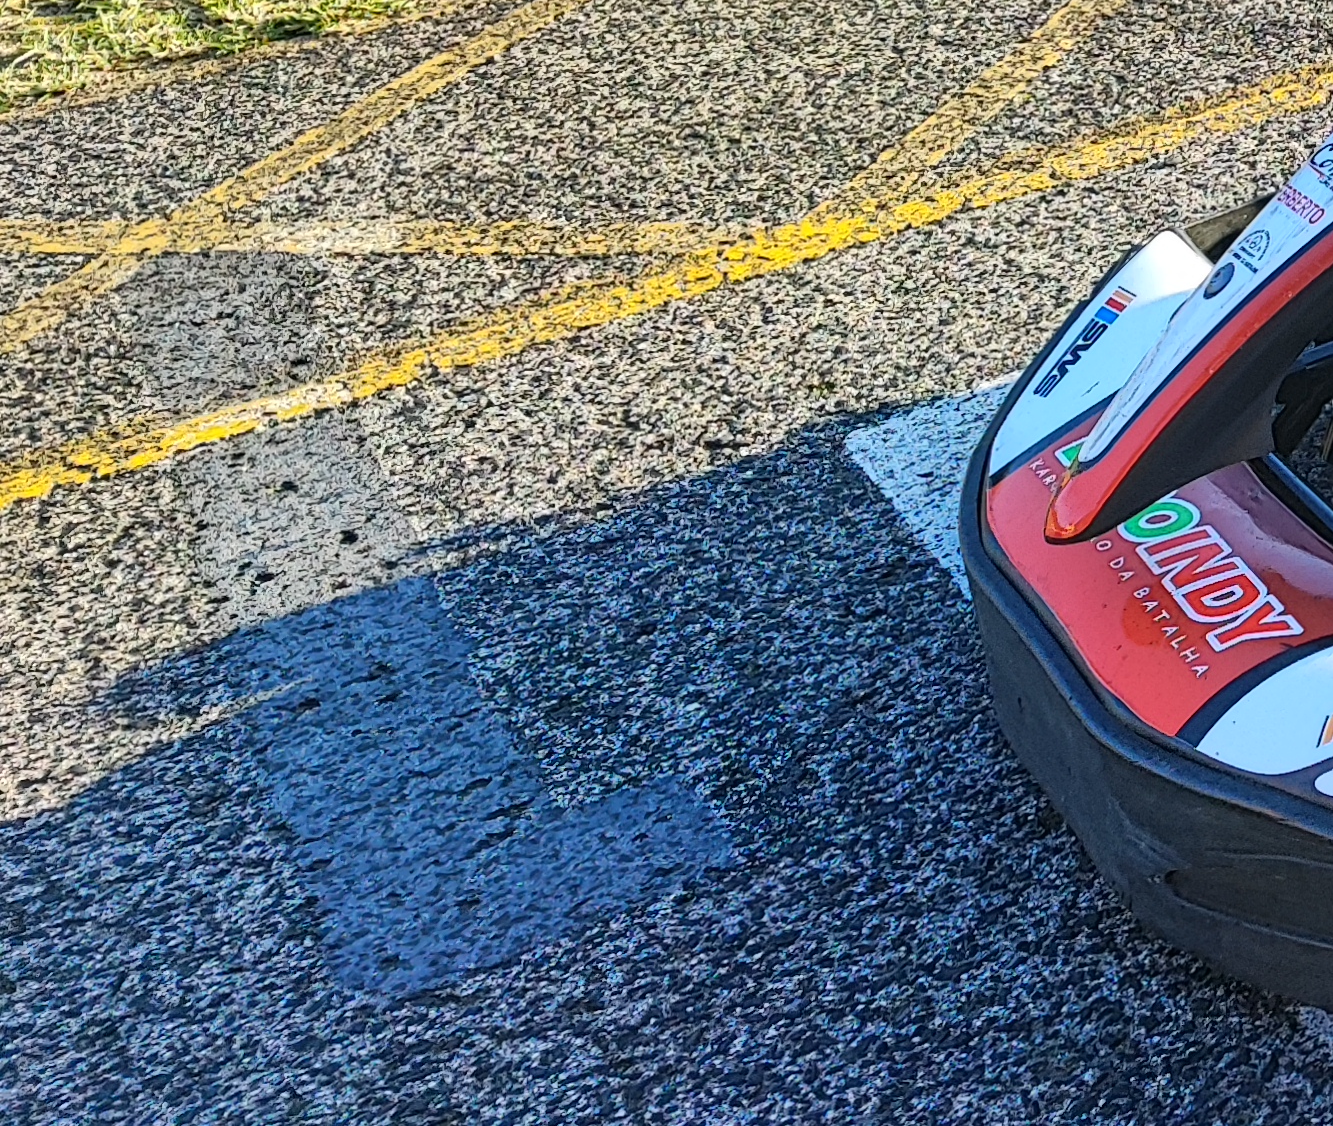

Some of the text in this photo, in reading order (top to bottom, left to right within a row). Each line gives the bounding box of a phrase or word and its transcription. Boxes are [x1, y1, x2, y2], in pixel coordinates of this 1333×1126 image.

[1277, 183, 1326, 225] ERBERTO
[1032, 316, 1110, 399] SWS
[1109, 555, 1210, 679] DA BATALHA
